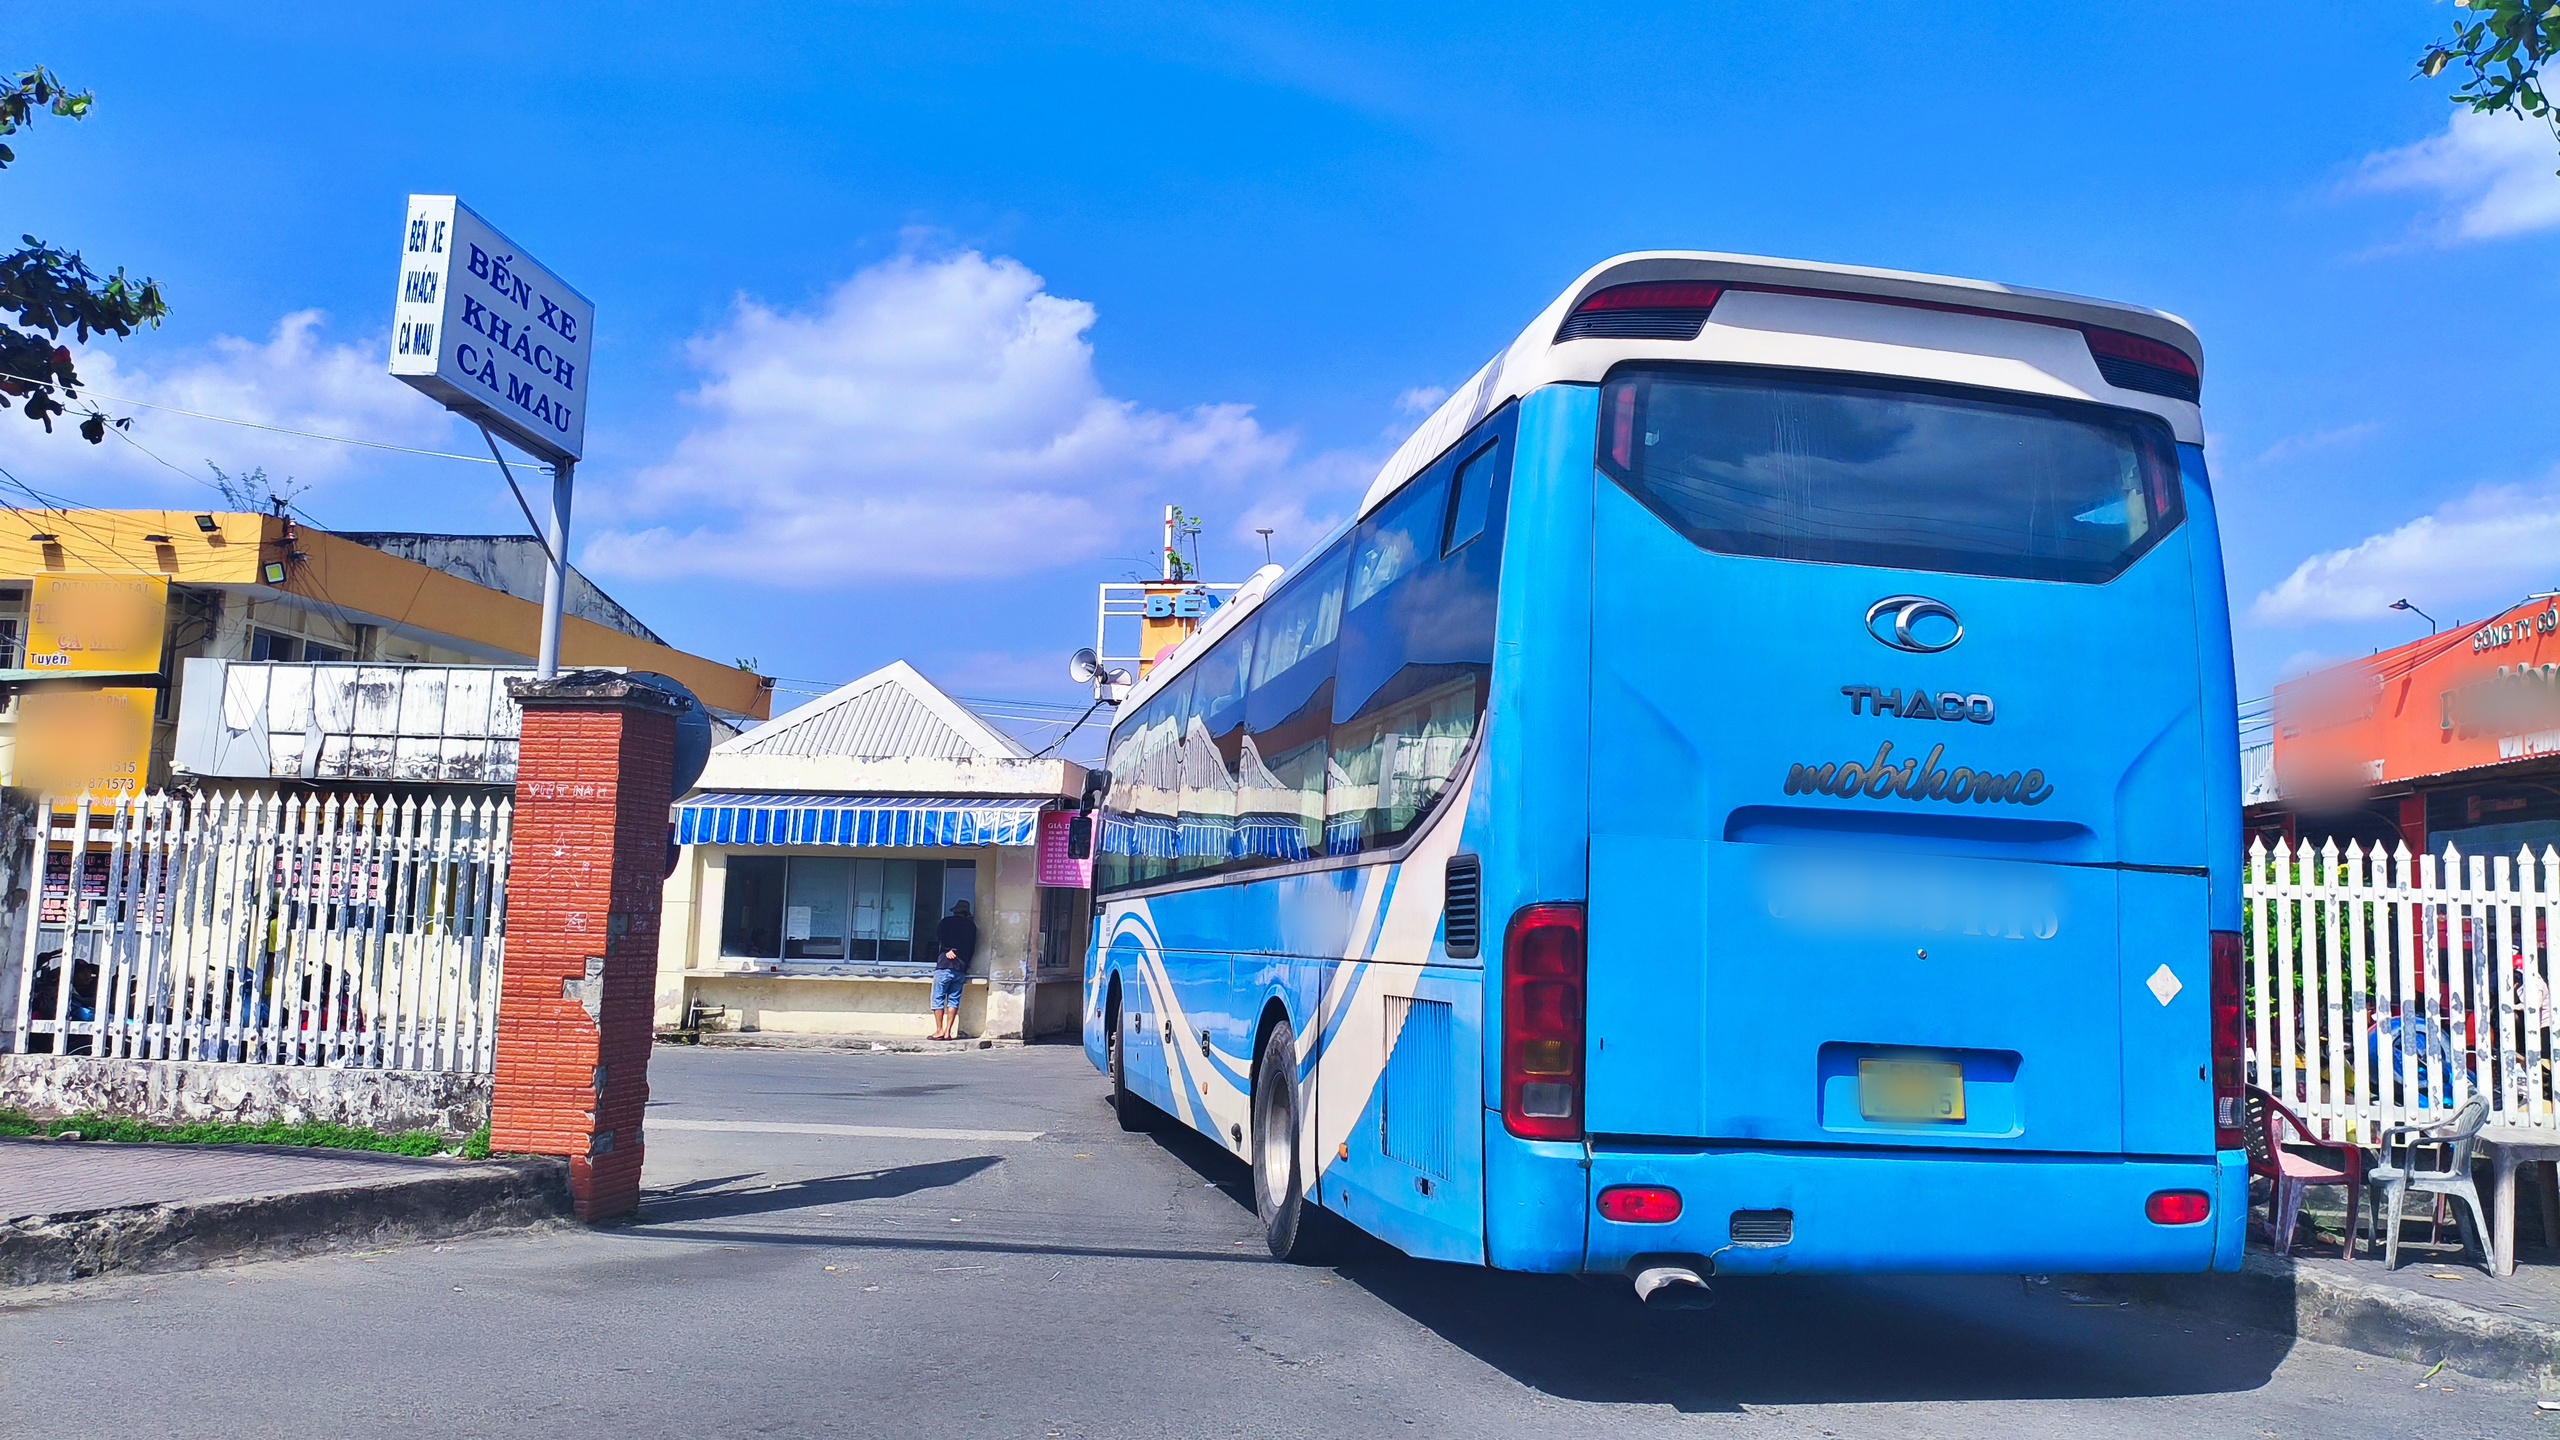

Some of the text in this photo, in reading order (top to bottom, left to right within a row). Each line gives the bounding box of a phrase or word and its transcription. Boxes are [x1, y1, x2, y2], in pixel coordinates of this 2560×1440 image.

[409, 211, 446, 254] BẾN XE
[405, 264, 438, 304] KHÁCH
[467, 242, 578, 344] BẾN XE
[398, 315, 434, 356] CÀ MAU
[462, 293, 575, 392] KHÁCH
[456, 343, 572, 433] CÀ MAU
[2473, 624, 2512, 652] CÔNG
[2514, 616, 2534, 640] TY
[1841, 684, 1996, 725] THACO
[1784, 740, 2054, 806] mobihome
